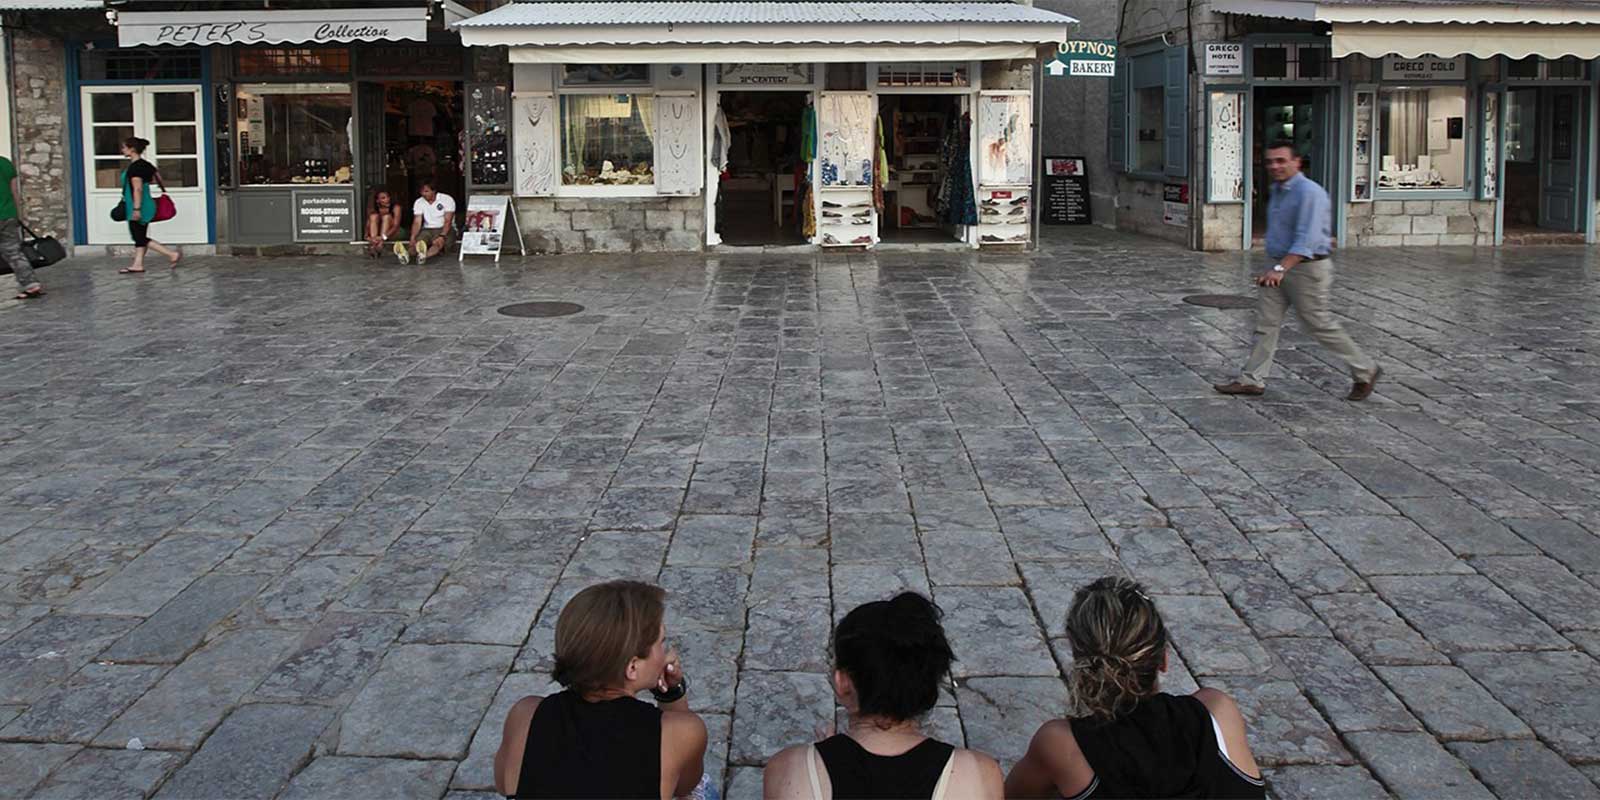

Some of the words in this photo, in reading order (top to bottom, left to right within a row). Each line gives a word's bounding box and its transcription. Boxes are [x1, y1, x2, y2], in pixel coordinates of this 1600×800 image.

[314, 23, 389, 40] Collection
[1058, 41, 1116, 58] ΟΥΡΝΟΣ
[1072, 62, 1114, 74] BAKERY
[1393, 62, 1425, 71] GRECO
